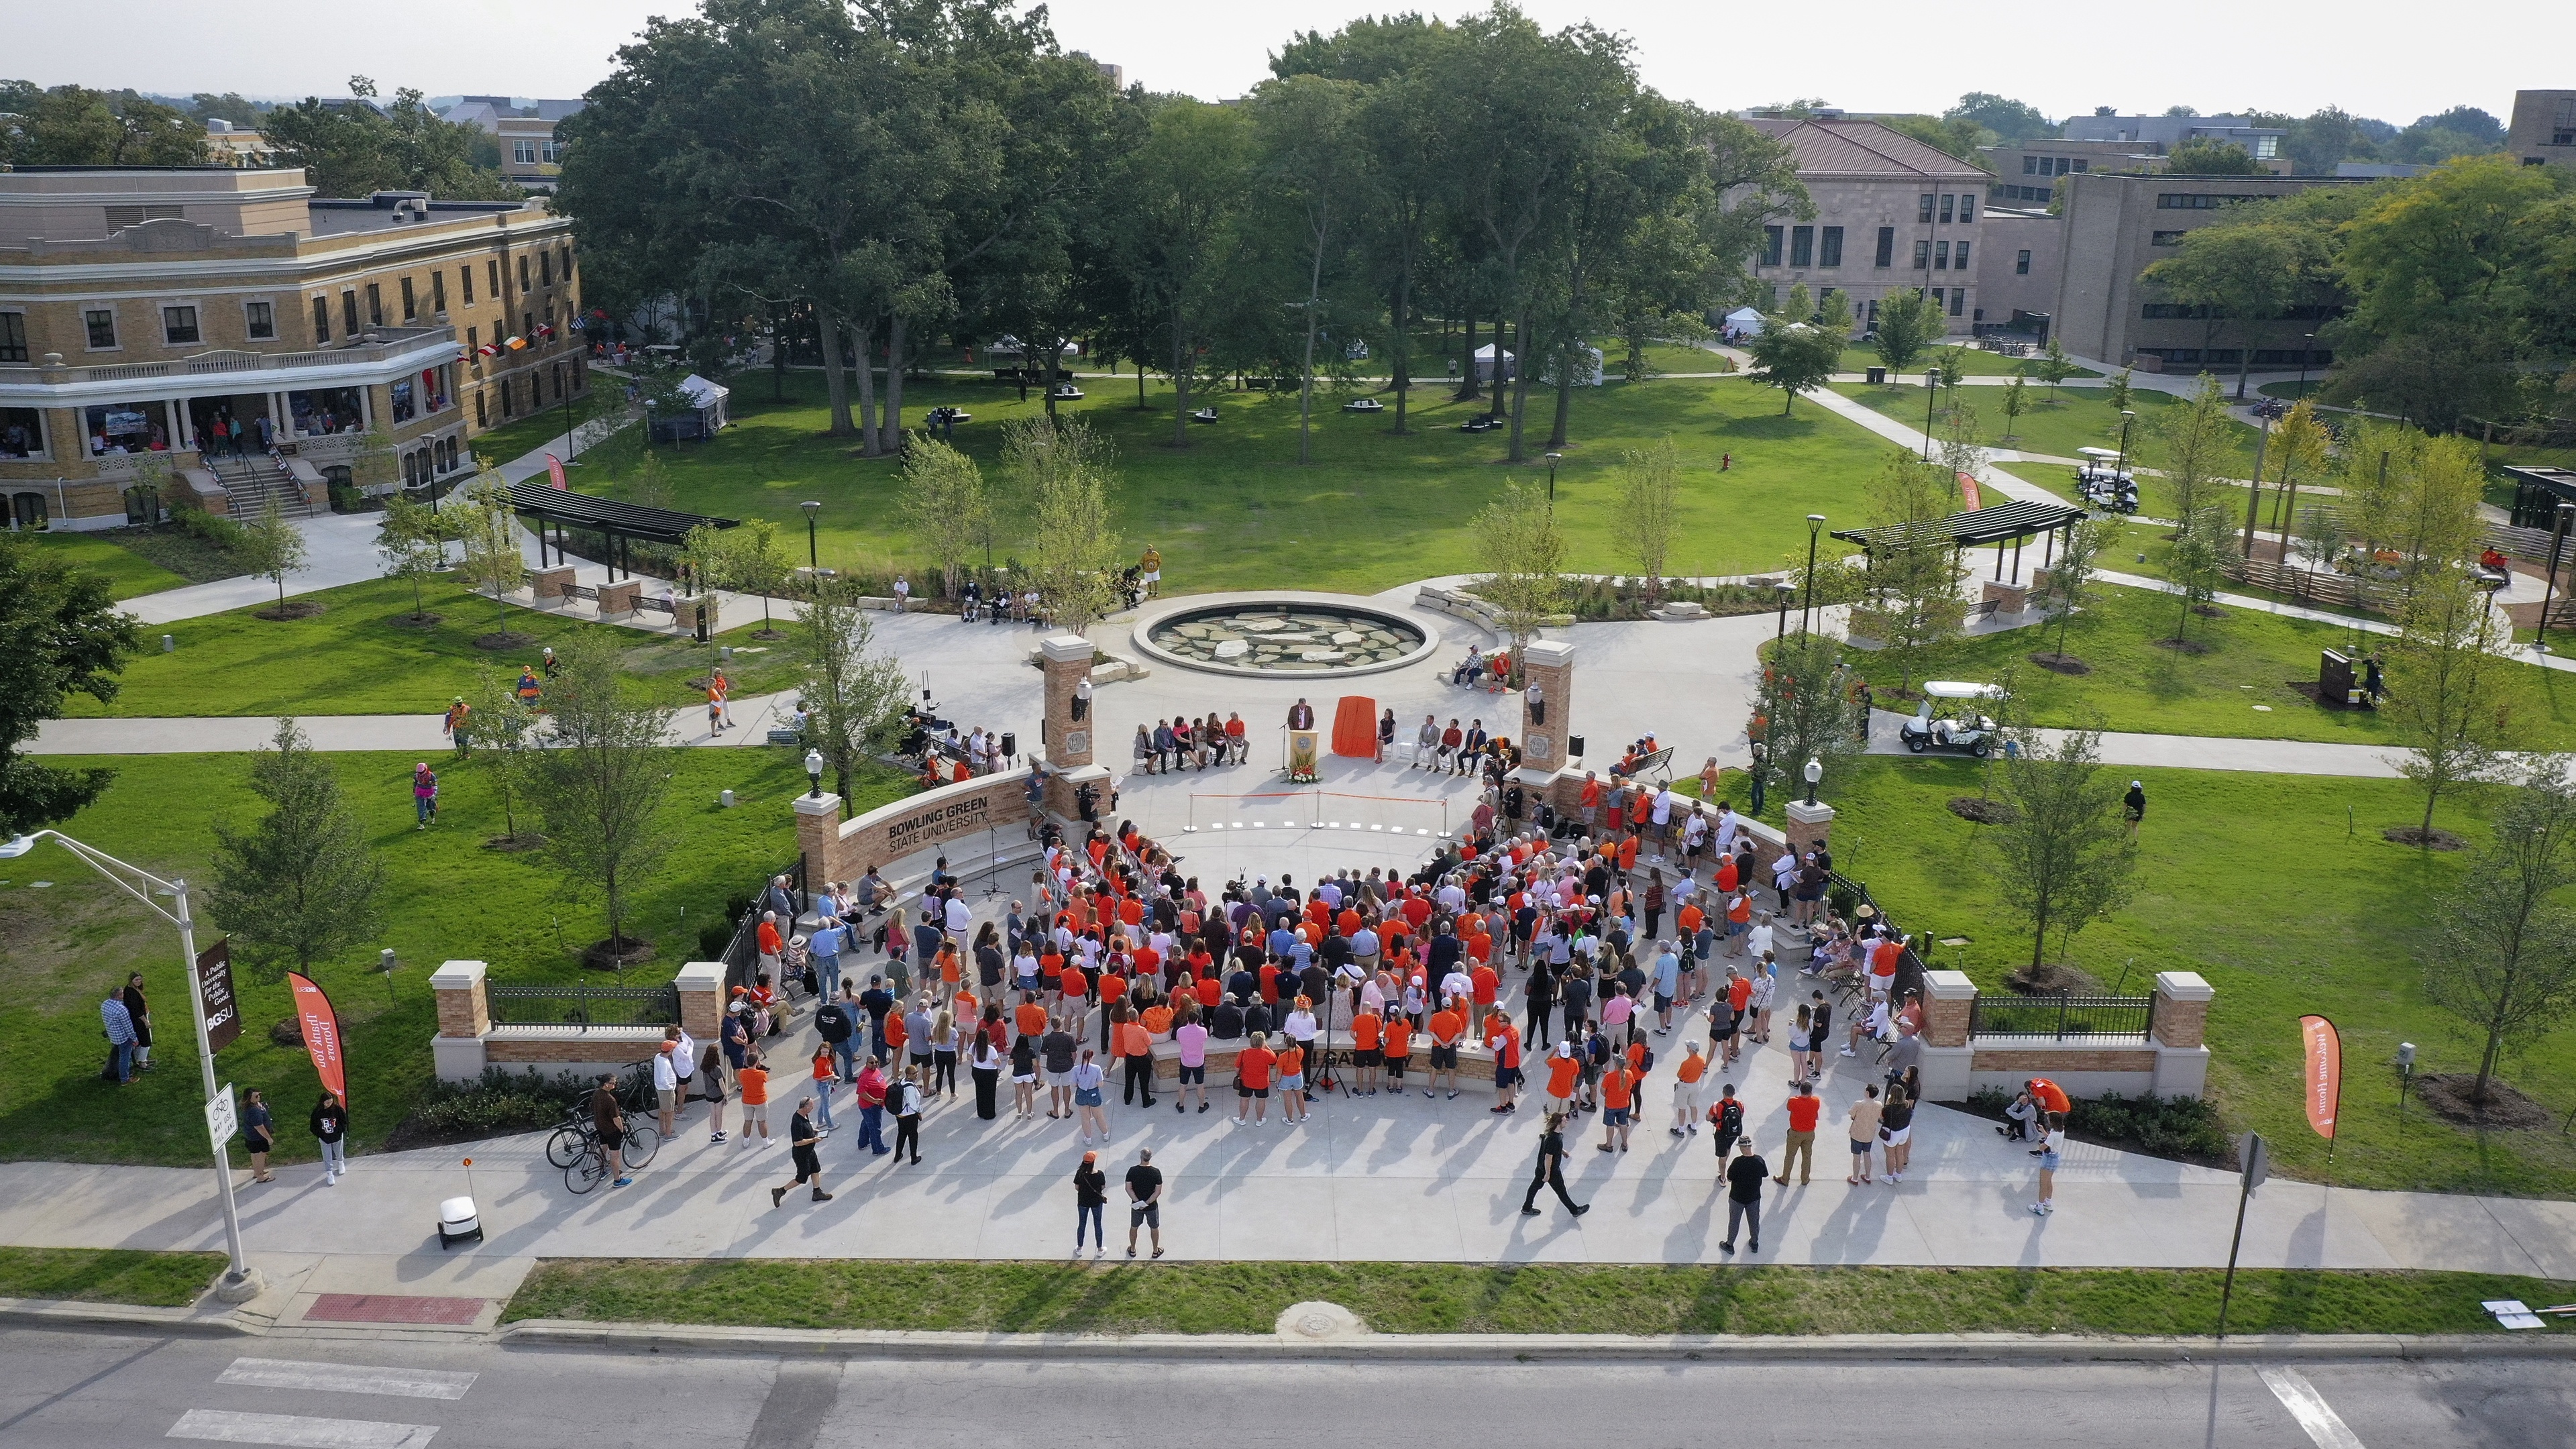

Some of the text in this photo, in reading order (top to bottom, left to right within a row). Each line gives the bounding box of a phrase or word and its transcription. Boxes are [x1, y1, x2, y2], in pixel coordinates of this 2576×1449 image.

[889, 796, 987, 839] BOWLING GREEN
[890, 810, 987, 853] STATE UNIVERSITY
[210, 960, 226, 975] Public
[201, 969, 227, 989] University
[204, 980, 221, 998] for the
[208, 987, 225, 1002] Public
[207, 1005, 233, 1031] BGSU
[213, 1121, 223, 1134] MAY
[214, 1120, 235, 1146] FULL LANE
